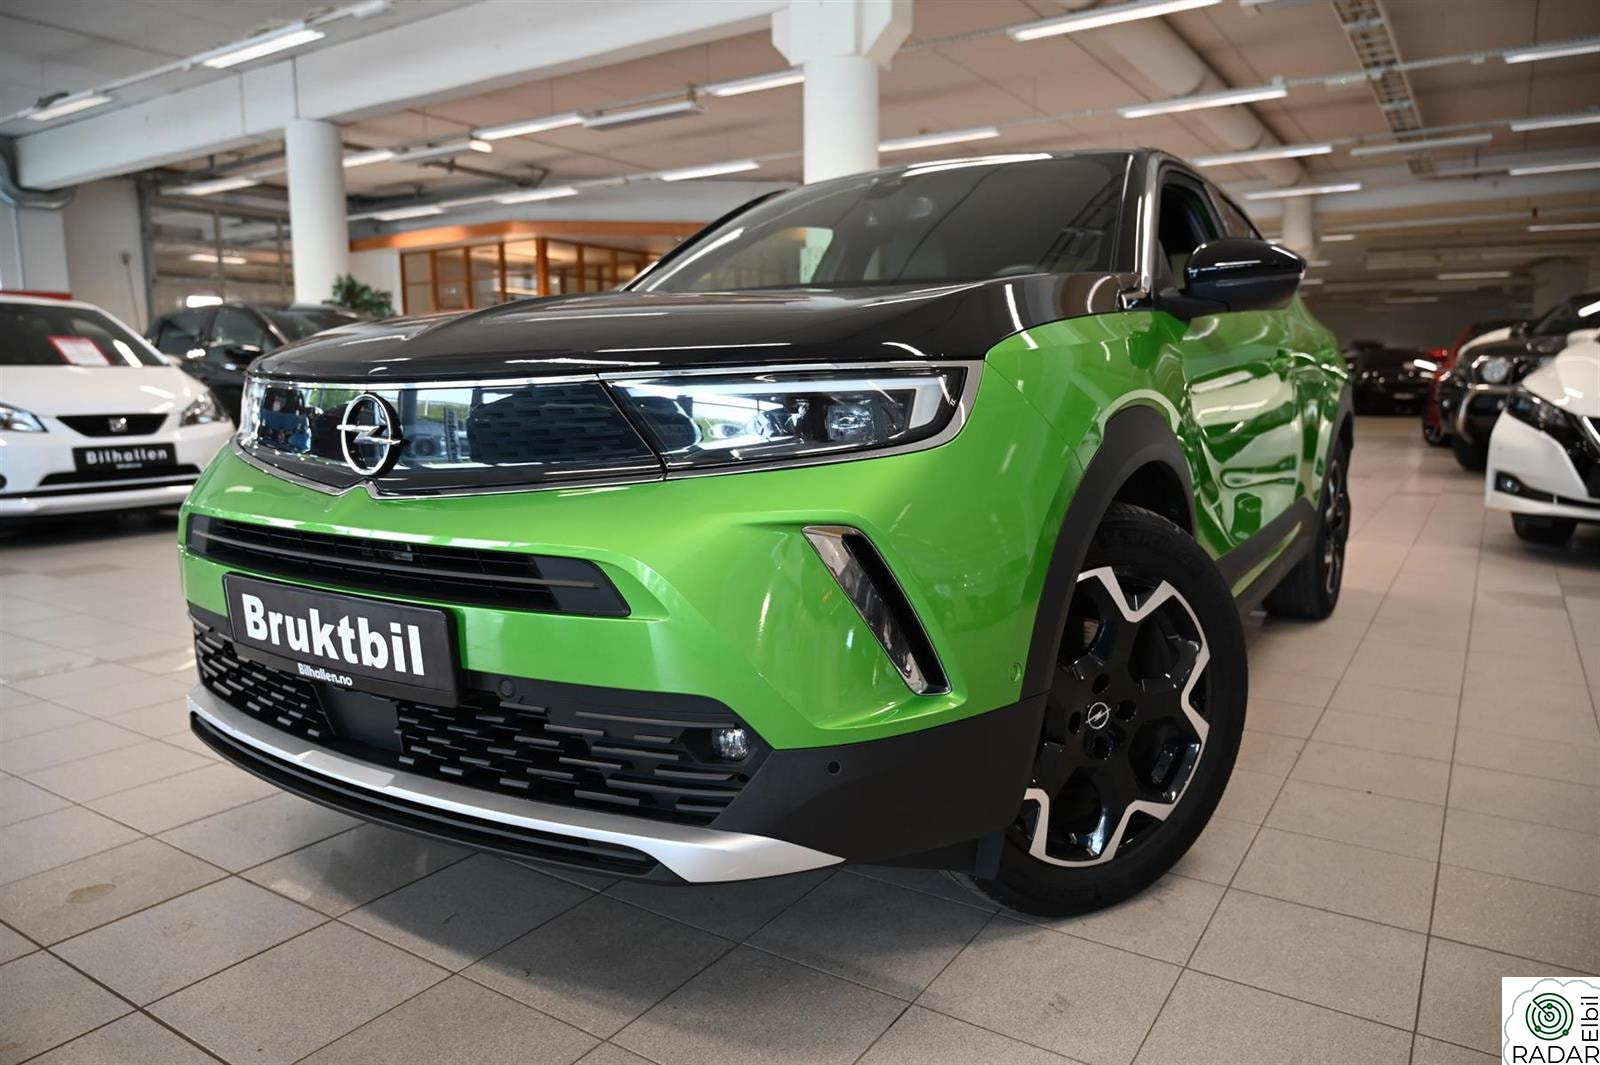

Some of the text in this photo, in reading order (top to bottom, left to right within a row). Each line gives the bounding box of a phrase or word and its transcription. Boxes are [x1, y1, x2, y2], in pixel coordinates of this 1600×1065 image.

[86, 448, 167, 464] Bilhallen
[241, 593, 425, 676] Bruktbil
[297, 662, 353, 686] Bilhallen.no
